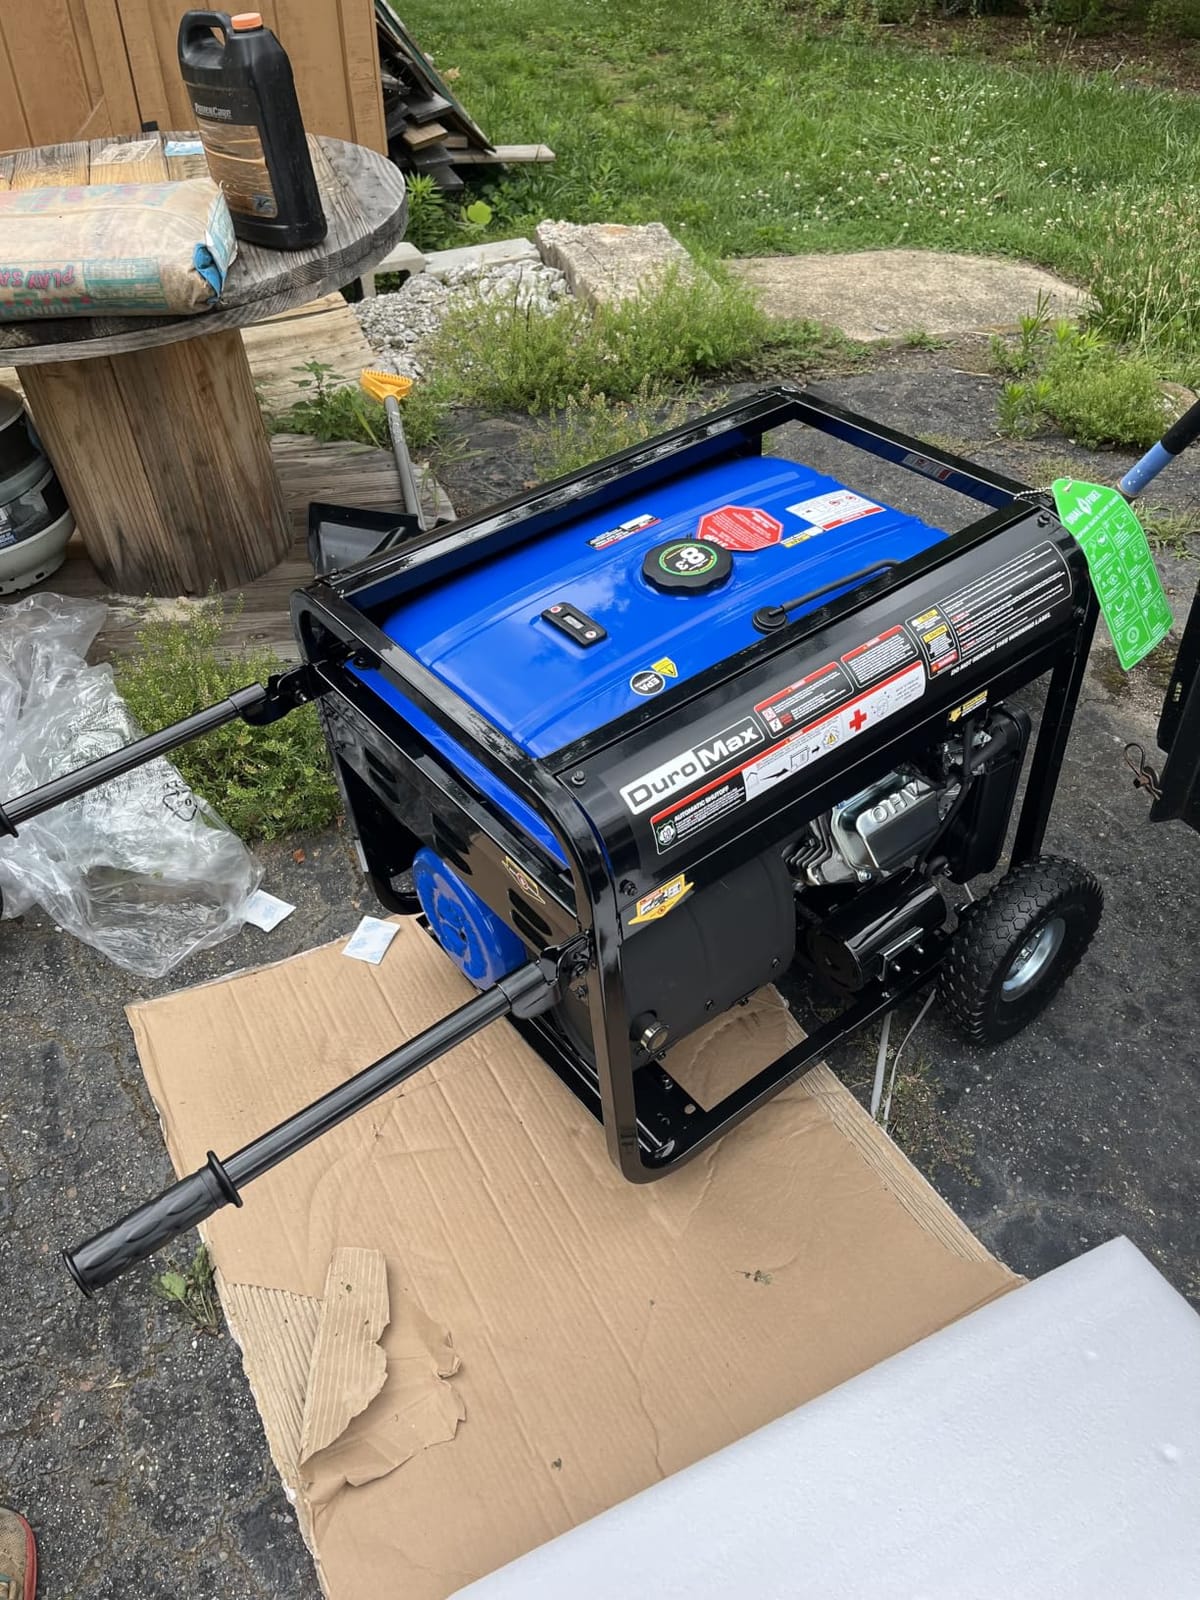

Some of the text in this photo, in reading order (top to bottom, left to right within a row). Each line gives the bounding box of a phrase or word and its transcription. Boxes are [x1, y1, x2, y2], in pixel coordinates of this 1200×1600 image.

[27, 265, 75, 289] PLAY
[639, 677, 661, 691] EPA
[871, 780, 921, 823] OHV
